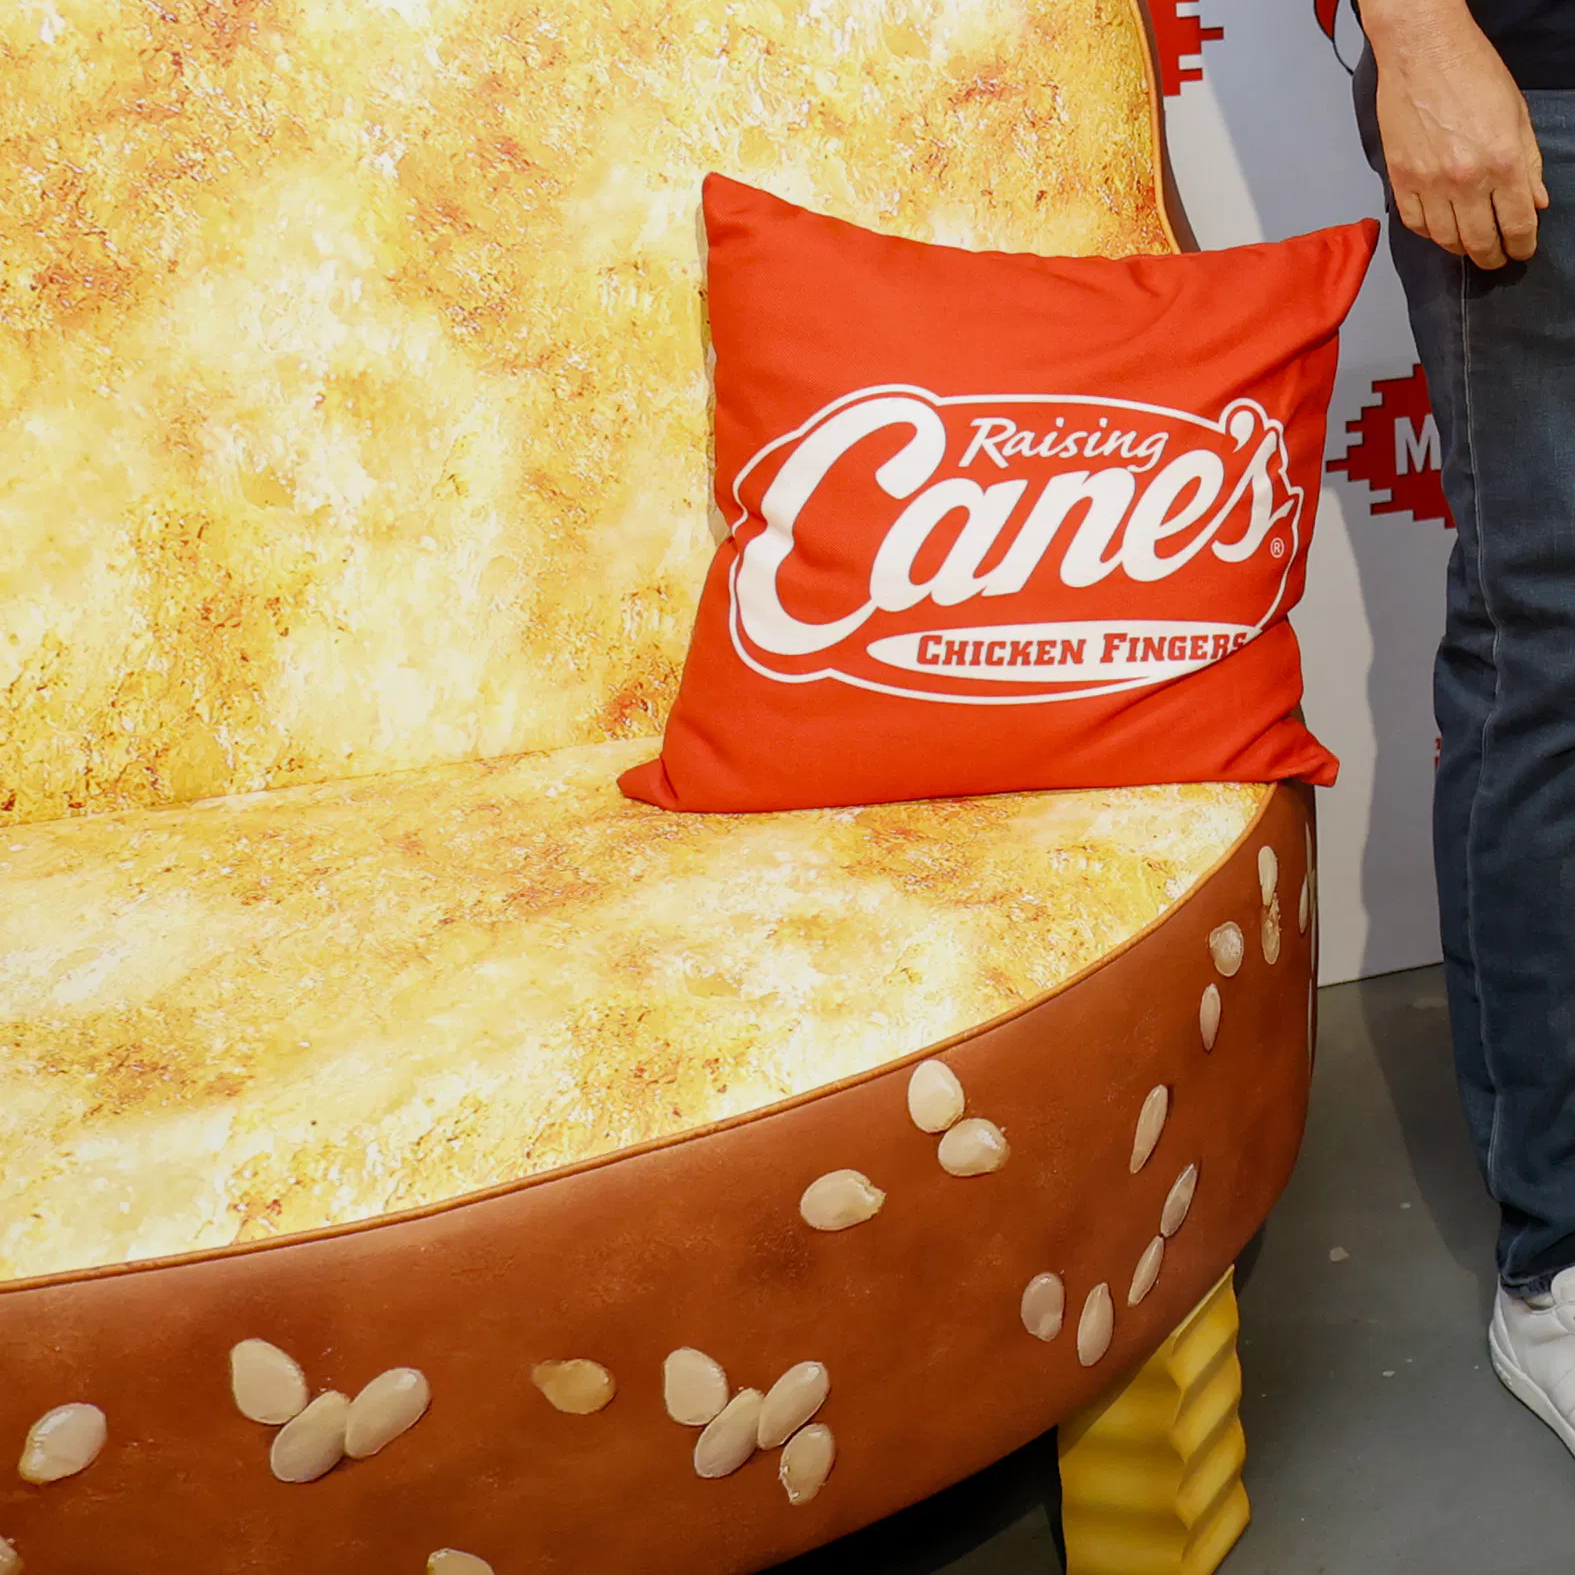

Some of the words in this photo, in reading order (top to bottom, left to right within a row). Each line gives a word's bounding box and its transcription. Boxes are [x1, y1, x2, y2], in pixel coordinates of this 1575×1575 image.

[959, 418, 1169, 473] Raising
[736, 395, 1293, 655] Cane's
[916, 634, 1087, 667] CHICKEN
